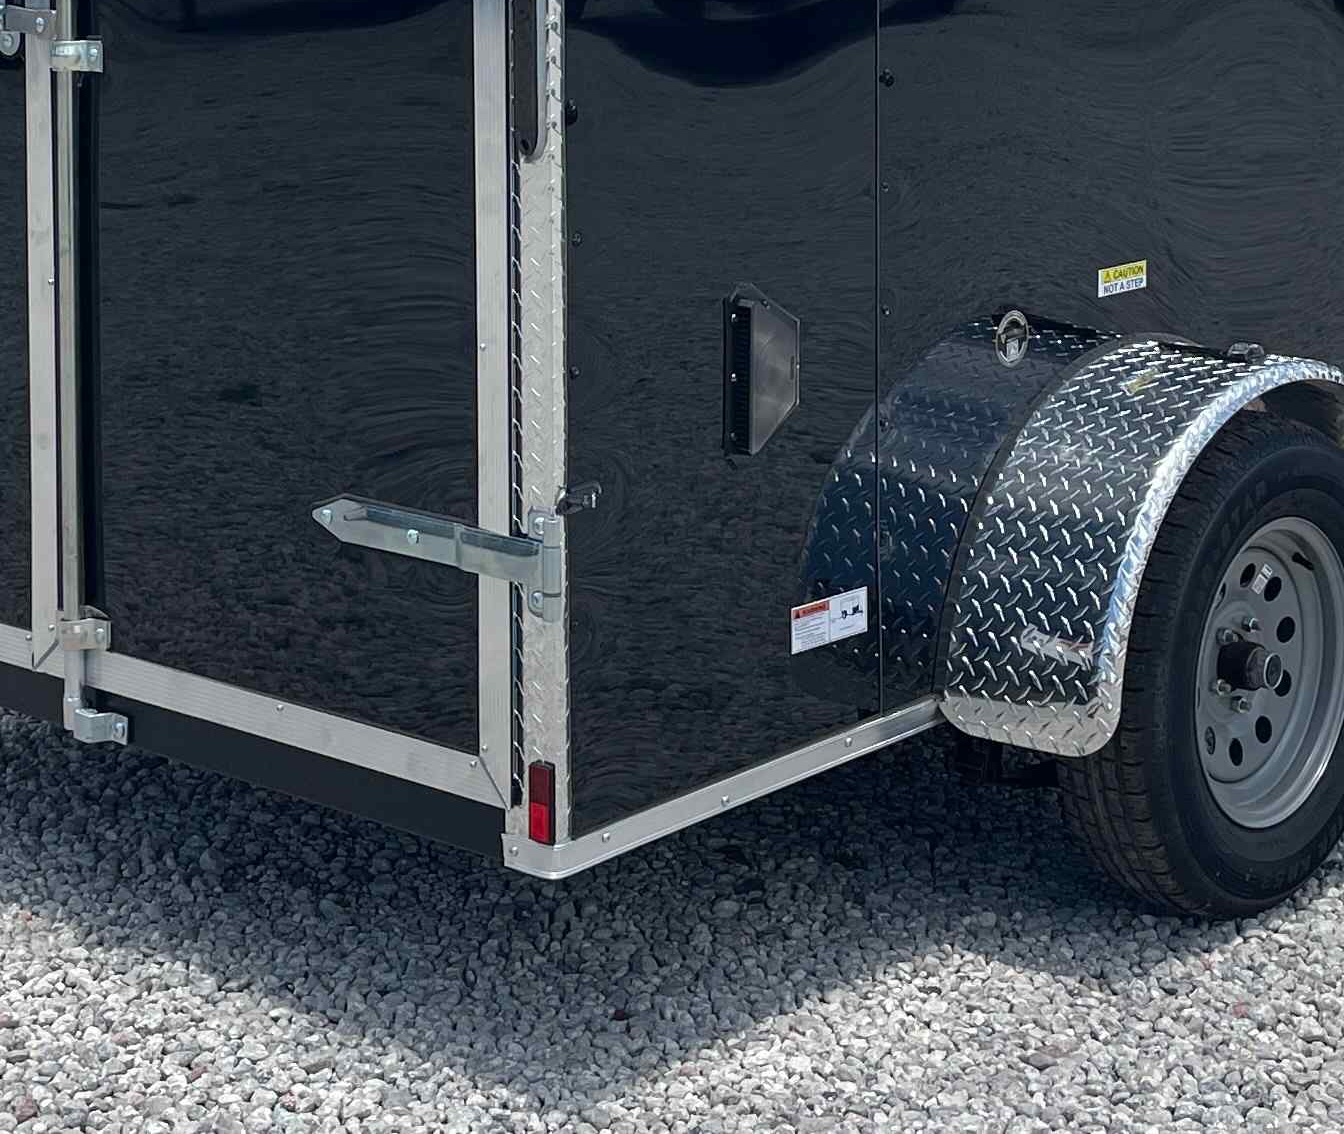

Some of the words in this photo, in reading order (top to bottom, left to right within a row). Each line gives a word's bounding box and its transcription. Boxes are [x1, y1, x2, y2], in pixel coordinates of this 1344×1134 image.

[1113, 265, 1144, 280] CAUTION
[1103, 282, 1118, 295] NOT
[1119, 282, 1125, 291] A
[1126, 278, 1144, 290] STEP
